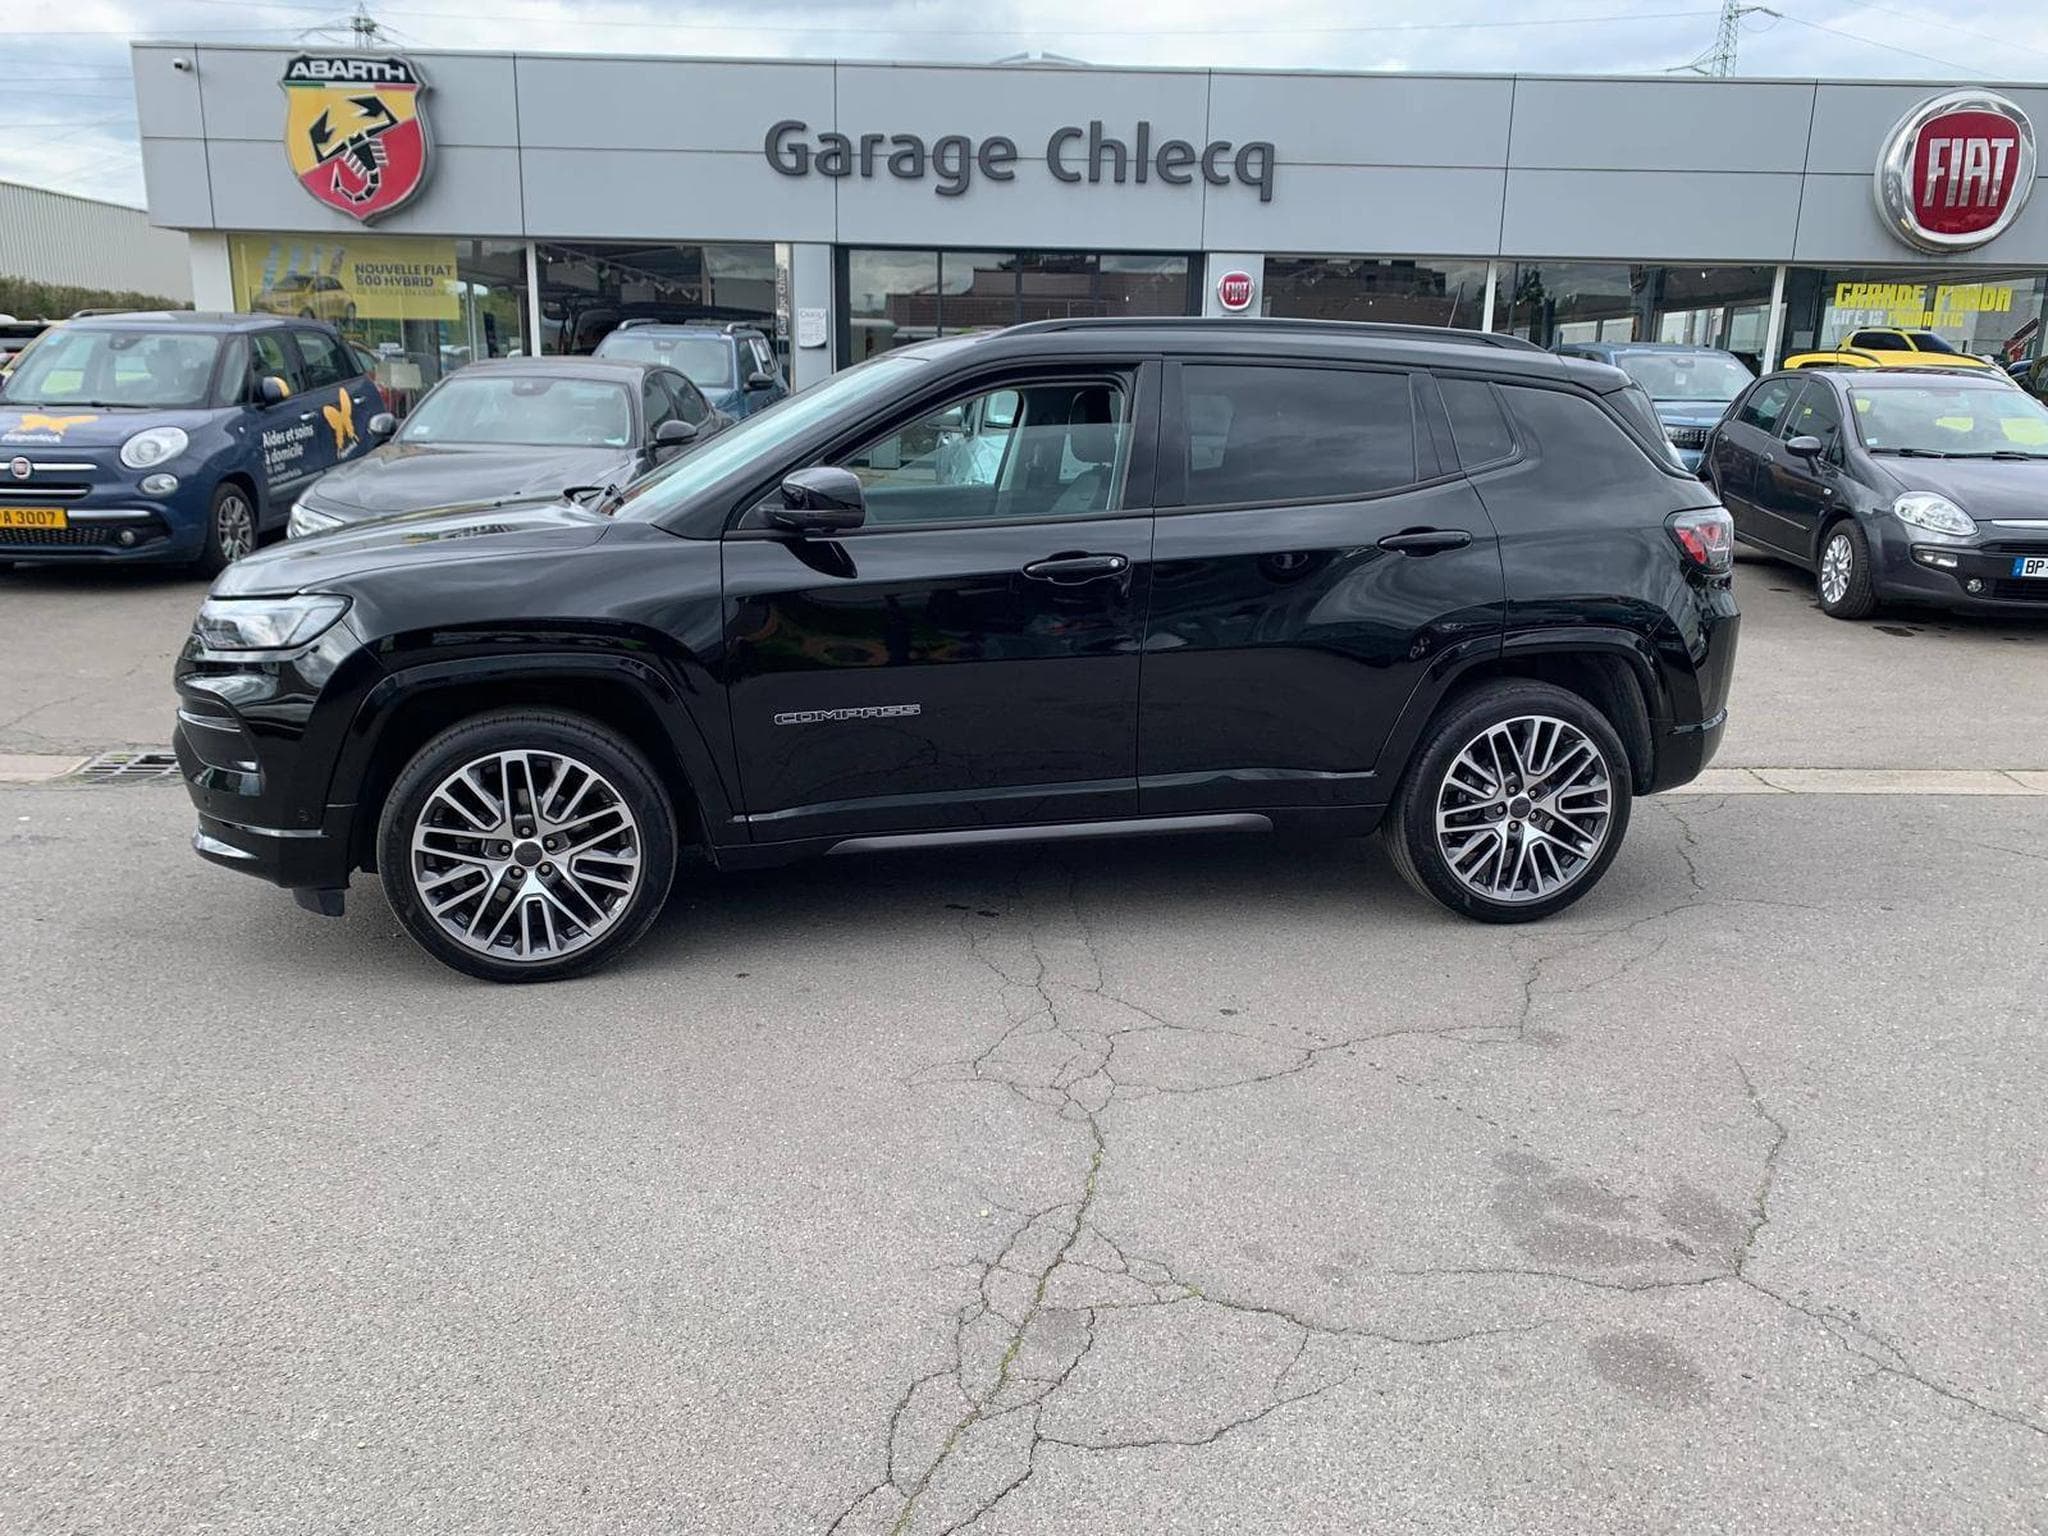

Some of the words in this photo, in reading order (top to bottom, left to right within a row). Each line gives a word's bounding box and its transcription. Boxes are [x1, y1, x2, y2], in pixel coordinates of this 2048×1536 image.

[289, 59, 406, 81] ABARTH
[764, 119, 1018, 197] Garage
[1046, 120, 1276, 203] Chlecq
[1922, 137, 2015, 208] FIAT
[355, 263, 420, 275] NOUVELLE
[423, 264, 453, 276] FIAT
[356, 275, 381, 286] 500
[384, 276, 434, 287] HYBRID
[1224, 281, 1249, 300] FIAT
[1834, 283, 1928, 309] GRANDE
[1831, 310, 1865, 325] LIFE
[1868, 310, 1883, 326] IS
[262, 429, 286, 449] Aides
[0, 511, 12, 525] A
[16, 511, 56, 525] 3007
[2025, 560, 2048, 575] BP
[774, 703, 921, 726] COMPASS
